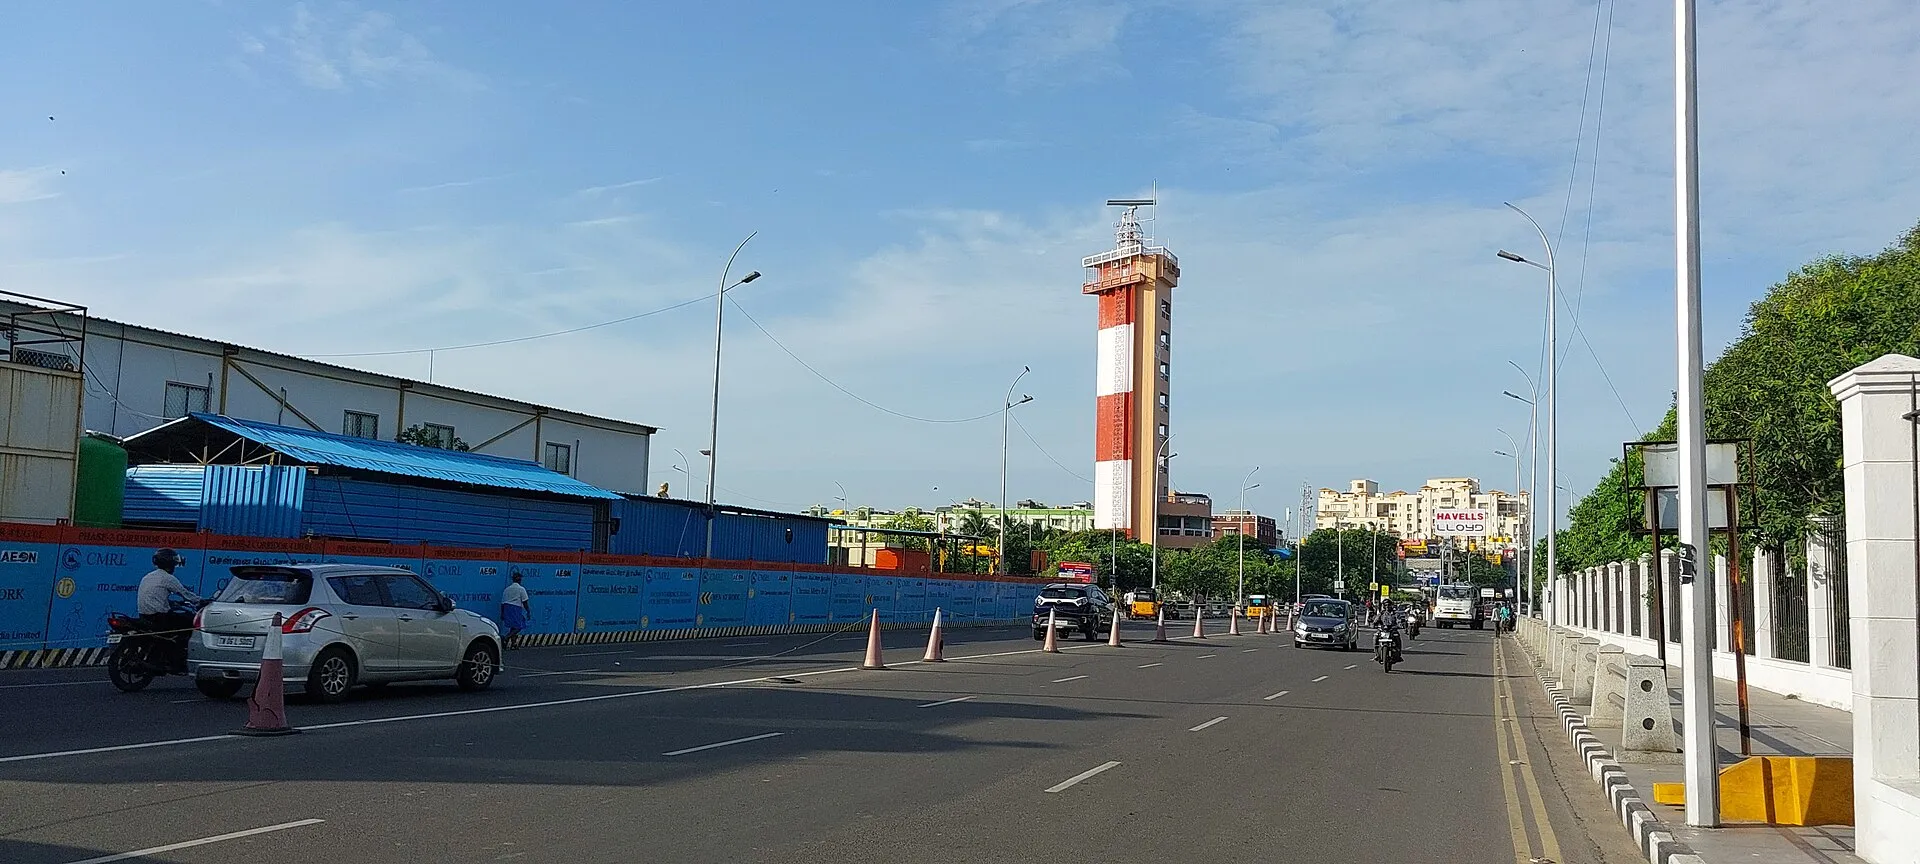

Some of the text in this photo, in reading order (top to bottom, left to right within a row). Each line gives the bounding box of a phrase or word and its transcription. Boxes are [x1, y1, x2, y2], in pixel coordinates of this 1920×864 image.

[1, 551, 36, 562] AEON
[86, 552, 126, 566] CMRL
[438, 565, 461, 576] CMRL
